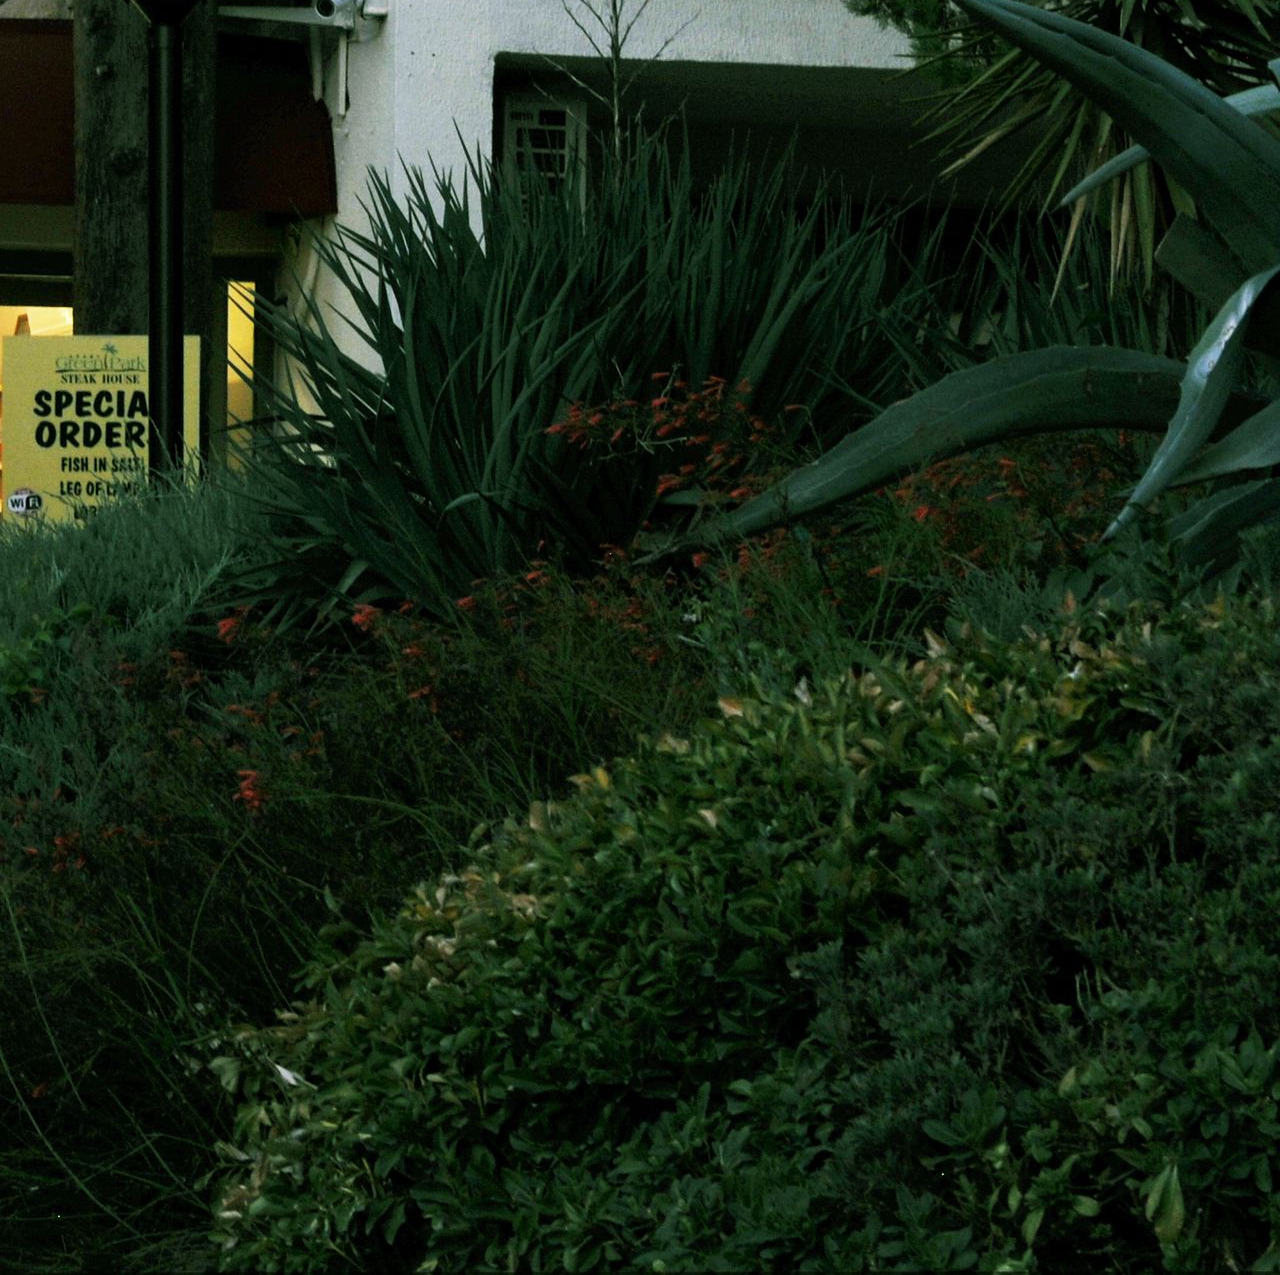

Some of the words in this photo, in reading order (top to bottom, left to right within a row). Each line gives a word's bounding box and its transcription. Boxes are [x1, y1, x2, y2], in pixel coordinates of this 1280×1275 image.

[60, 374, 97, 384] STEAK
[102, 374, 140, 384] HOUSE
[33, 389, 148, 418] SPECIA
[35, 421, 148, 448] ORDER
[61, 457, 88, 472] FISH
[94, 457, 107, 472] IN
[60, 481, 81, 496] LEG
[86, 481, 102, 496] OF
